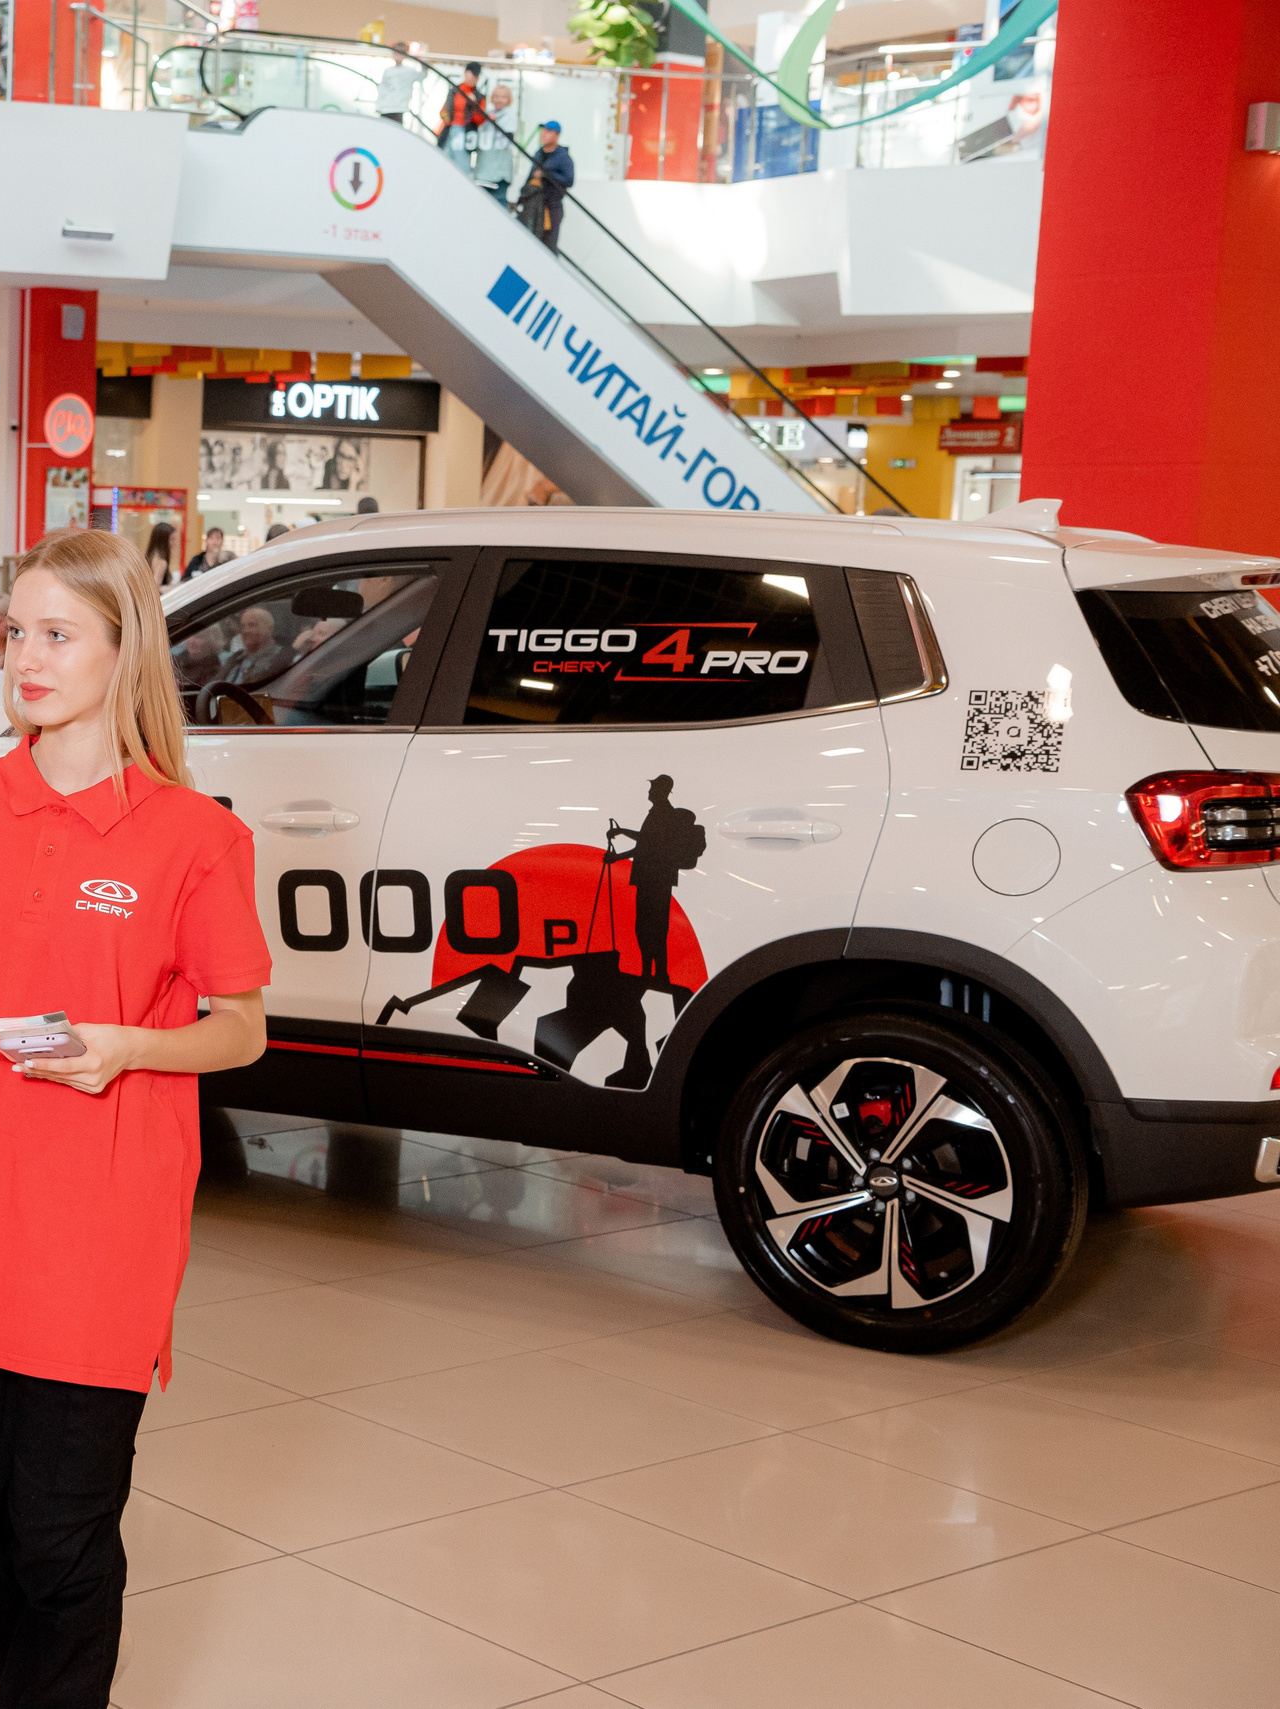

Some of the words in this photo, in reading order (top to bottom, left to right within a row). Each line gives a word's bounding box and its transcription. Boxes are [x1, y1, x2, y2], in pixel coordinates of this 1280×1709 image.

[287, 382, 381, 421] OPTIK
[488, 628, 637, 653] TIGGO
[641, 628, 695, 673] 4
[700, 650, 809, 675] PRO
[532, 660, 612, 674] CHERY
[75, 899, 134, 920] CHERY
